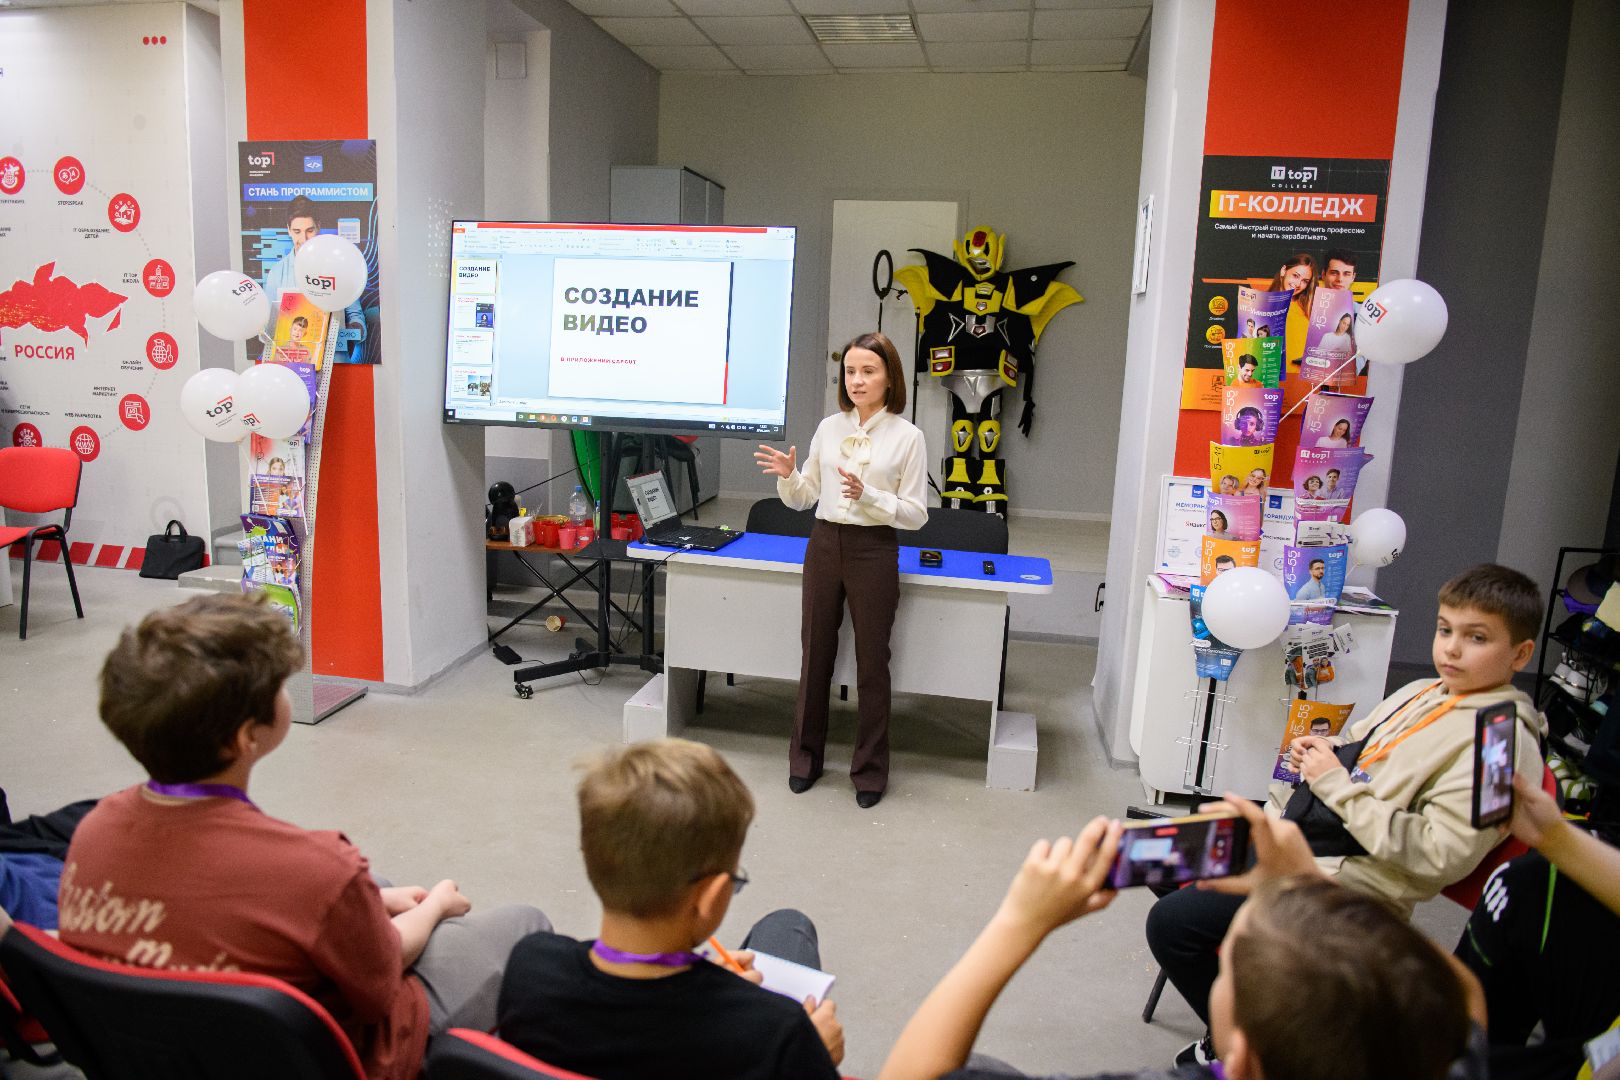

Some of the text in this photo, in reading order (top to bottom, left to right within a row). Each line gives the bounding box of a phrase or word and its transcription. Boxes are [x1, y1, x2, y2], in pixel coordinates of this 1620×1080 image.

[248, 154, 272, 168] top
[1288, 170, 1312, 183] top
[248, 186, 369, 197] СТАНЬ ПРОГРАММИСТОМ
[1218, 194, 1365, 219] IT-КОЛЛЕДЖ
[1239, 223, 1269, 232] быстрый
[1295, 226, 1326, 234] получить
[1327, 227, 1366, 235] профессию
[232, 281, 256, 297] top
[305, 274, 332, 290] top
[564, 287, 699, 309] СОЗДАНИЕ
[1364, 299, 1382, 319] top
[563, 314, 648, 336] ВИДЕО
[15, 344, 75, 360] РОССИЯ
[1262, 342, 1277, 350] top
[1263, 393, 1279, 401] top
[205, 399, 233, 418] top
[243, 415, 256, 427] op
[1311, 452, 1327, 461] top
